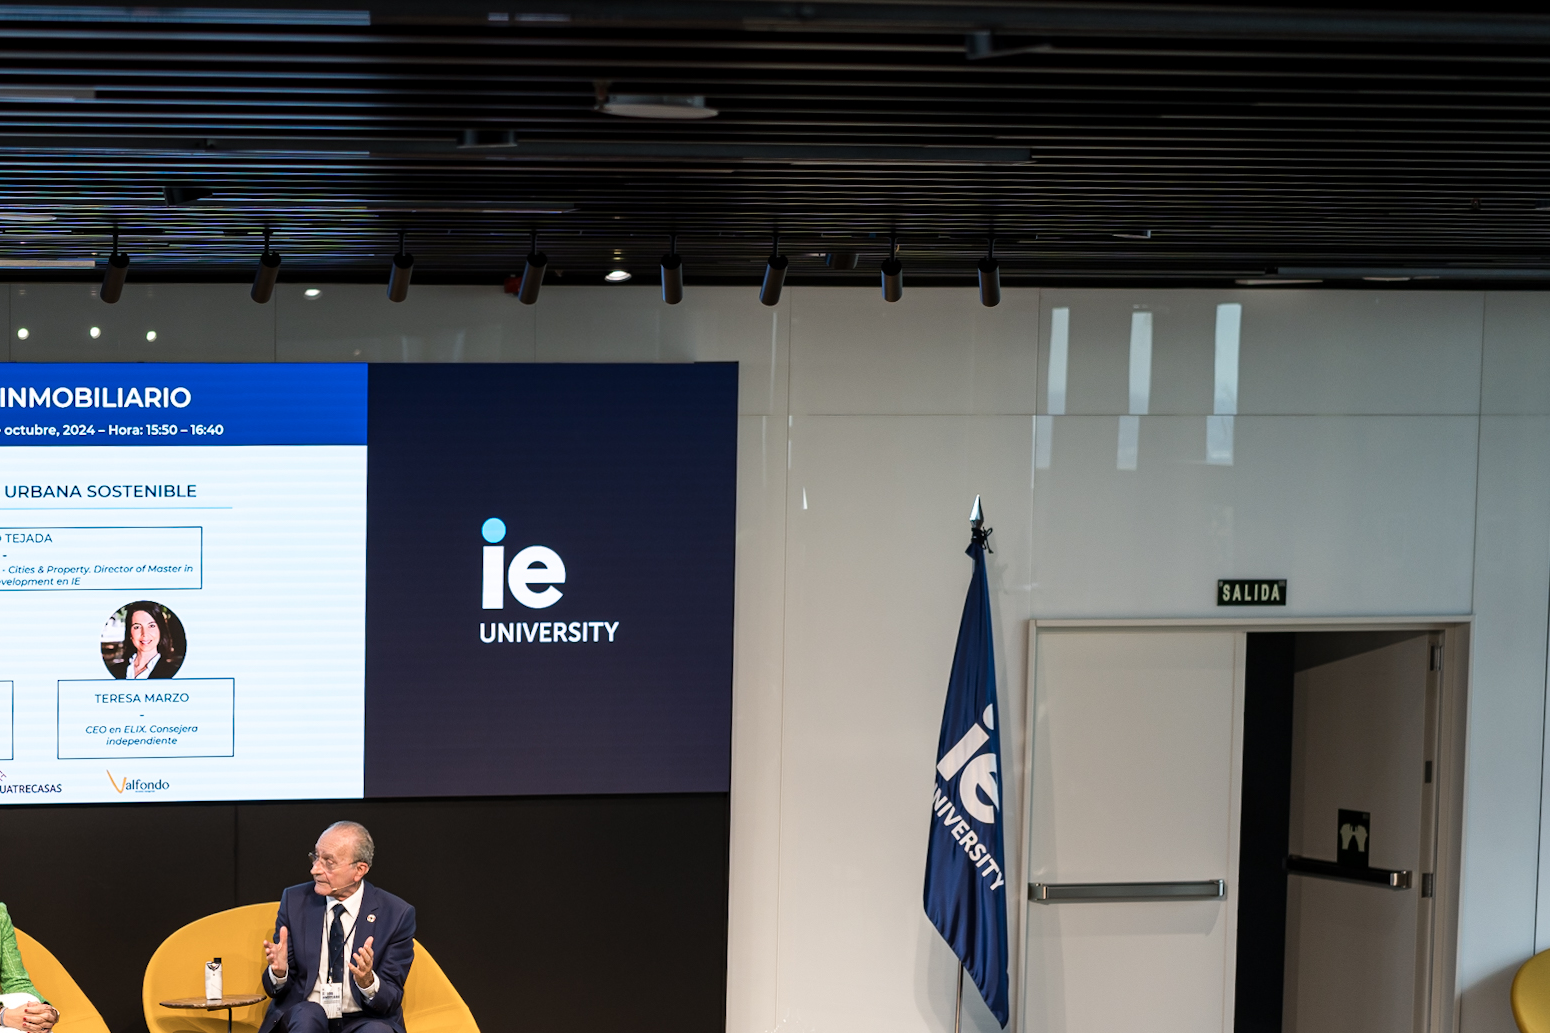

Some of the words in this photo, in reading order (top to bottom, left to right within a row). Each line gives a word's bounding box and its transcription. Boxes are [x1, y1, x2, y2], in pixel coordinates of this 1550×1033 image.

[0, 387, 191, 408] INMOBILIARIO
[3, 423, 61, 438] octubre,
[62, 424, 96, 436] 2024
[108, 424, 144, 436] Hora:
[145, 423, 179, 436] 15:50
[189, 423, 225, 436] 16:40
[4, 484, 83, 499] URBANA
[87, 484, 197, 498] SOSTENIBLE
[4, 533, 53, 544] TEJADA
[8, 565, 35, 574] Cities
[37, 565, 45, 574] &
[46, 565, 91, 576] Property.
[93, 564, 134, 574] Director
[135, 564, 147, 573] of
[147, 565, 182, 573] Master
[183, 564, 194, 572] in
[482, 518, 566, 609] ie
[56, 578, 69, 586] en
[71, 577, 80, 586] IE
[1222, 583, 1280, 602] SALIDA
[480, 622, 619, 643] UNIVERSITY
[94, 693, 142, 704] TERESA
[144, 692, 190, 703] MARZO
[85, 725, 107, 735] CEO
[123, 725, 147, 734] ELIX.
[149, 724, 199, 735] Consejera
[106, 736, 178, 747] independiente
[937, 704, 999, 824] ie
[933, 783, 1004, 891] NIVERSITY
